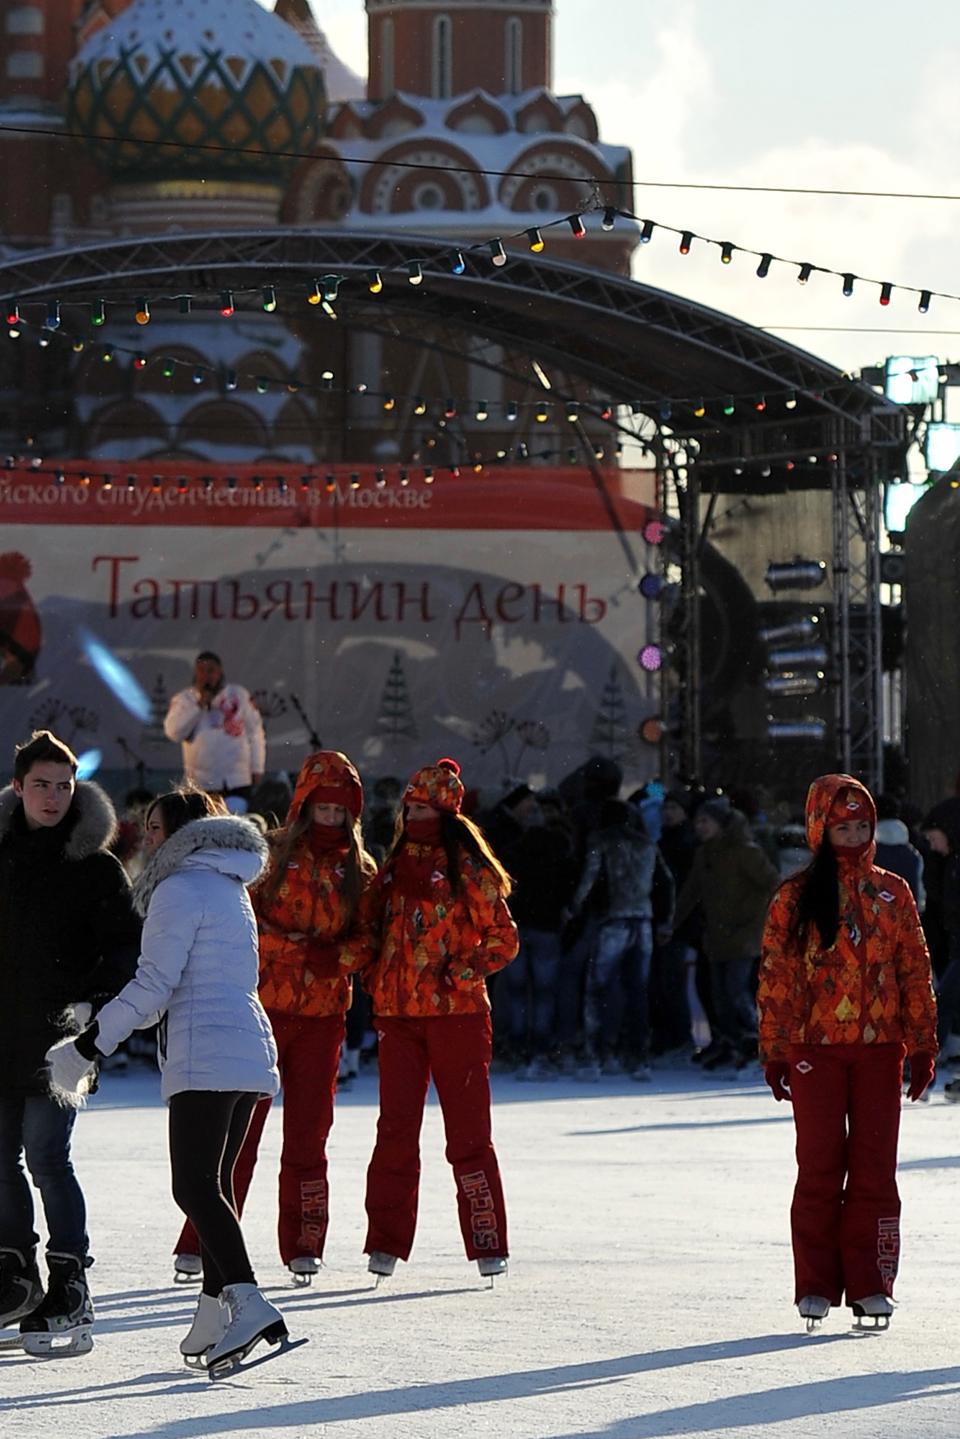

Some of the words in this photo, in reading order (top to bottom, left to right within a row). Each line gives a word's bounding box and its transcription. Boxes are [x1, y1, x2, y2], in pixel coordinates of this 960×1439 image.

[95, 483, 297, 516] студенчества
[309, 487, 321, 506] в
[328, 479, 434, 509] Москве
[91, 555, 436, 622] Татьянин
[453, 579, 609, 641] день
[460, 1170, 500, 1250] SOCHI
